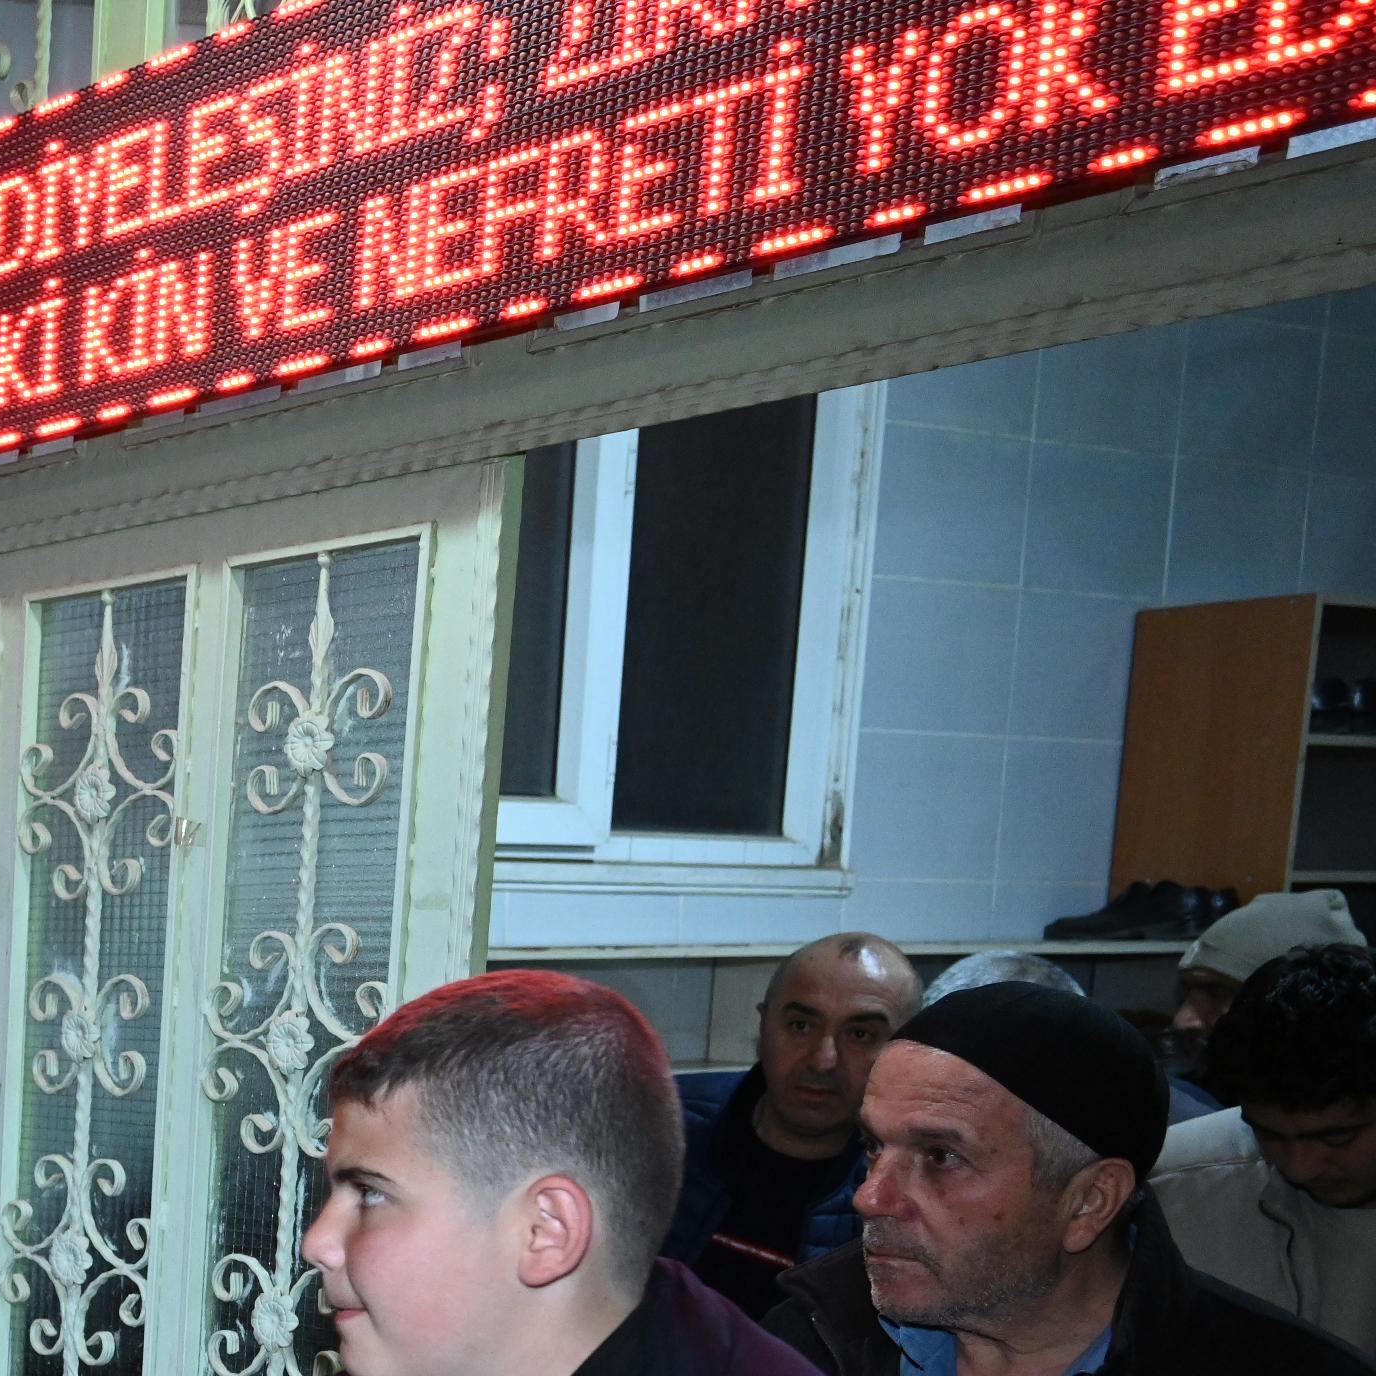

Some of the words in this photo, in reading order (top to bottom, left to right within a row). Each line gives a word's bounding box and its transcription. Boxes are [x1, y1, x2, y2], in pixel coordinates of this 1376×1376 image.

[80, 248, 216, 385] KİN
[232, 211, 343, 341] VE
[352, 39, 813, 308] NEFRETİ
[845, 0, 1121, 175] YOK
